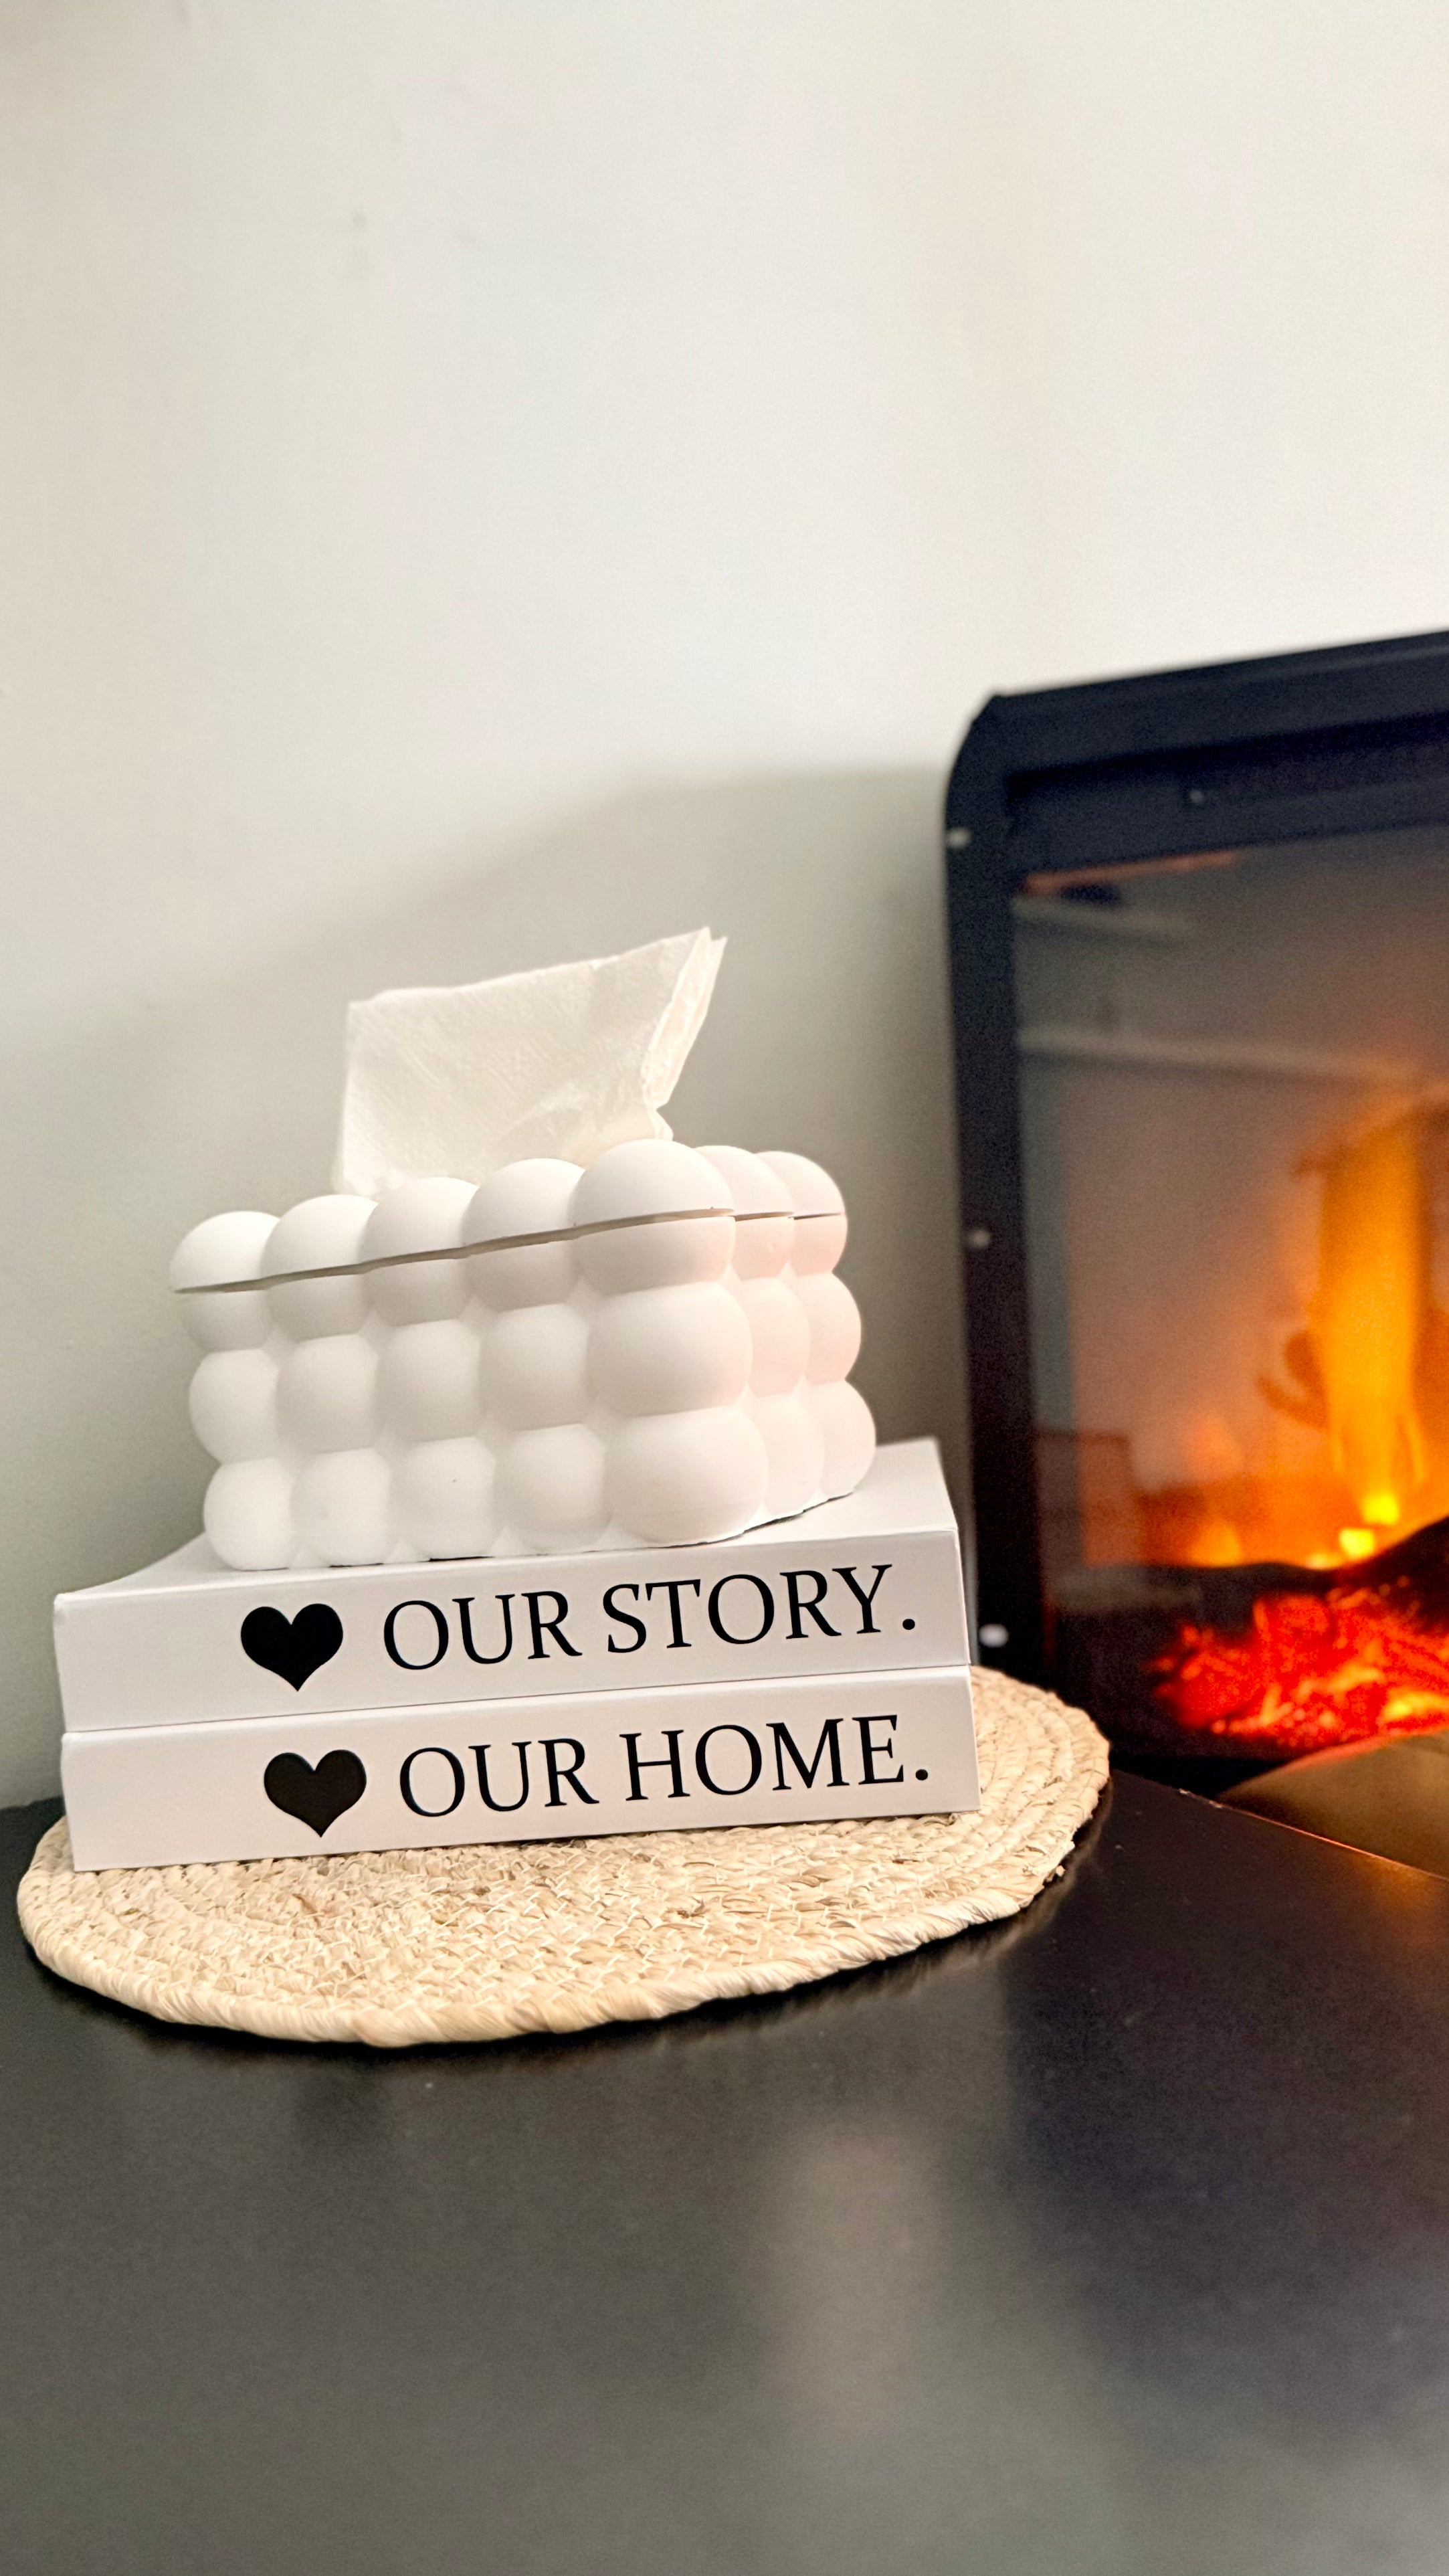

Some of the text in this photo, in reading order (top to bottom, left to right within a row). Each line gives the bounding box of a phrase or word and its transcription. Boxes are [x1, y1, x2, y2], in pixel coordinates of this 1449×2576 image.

[383, 1563, 916, 1671] OUR STORY.
[399, 1714, 929, 1818] OUR HOME.
